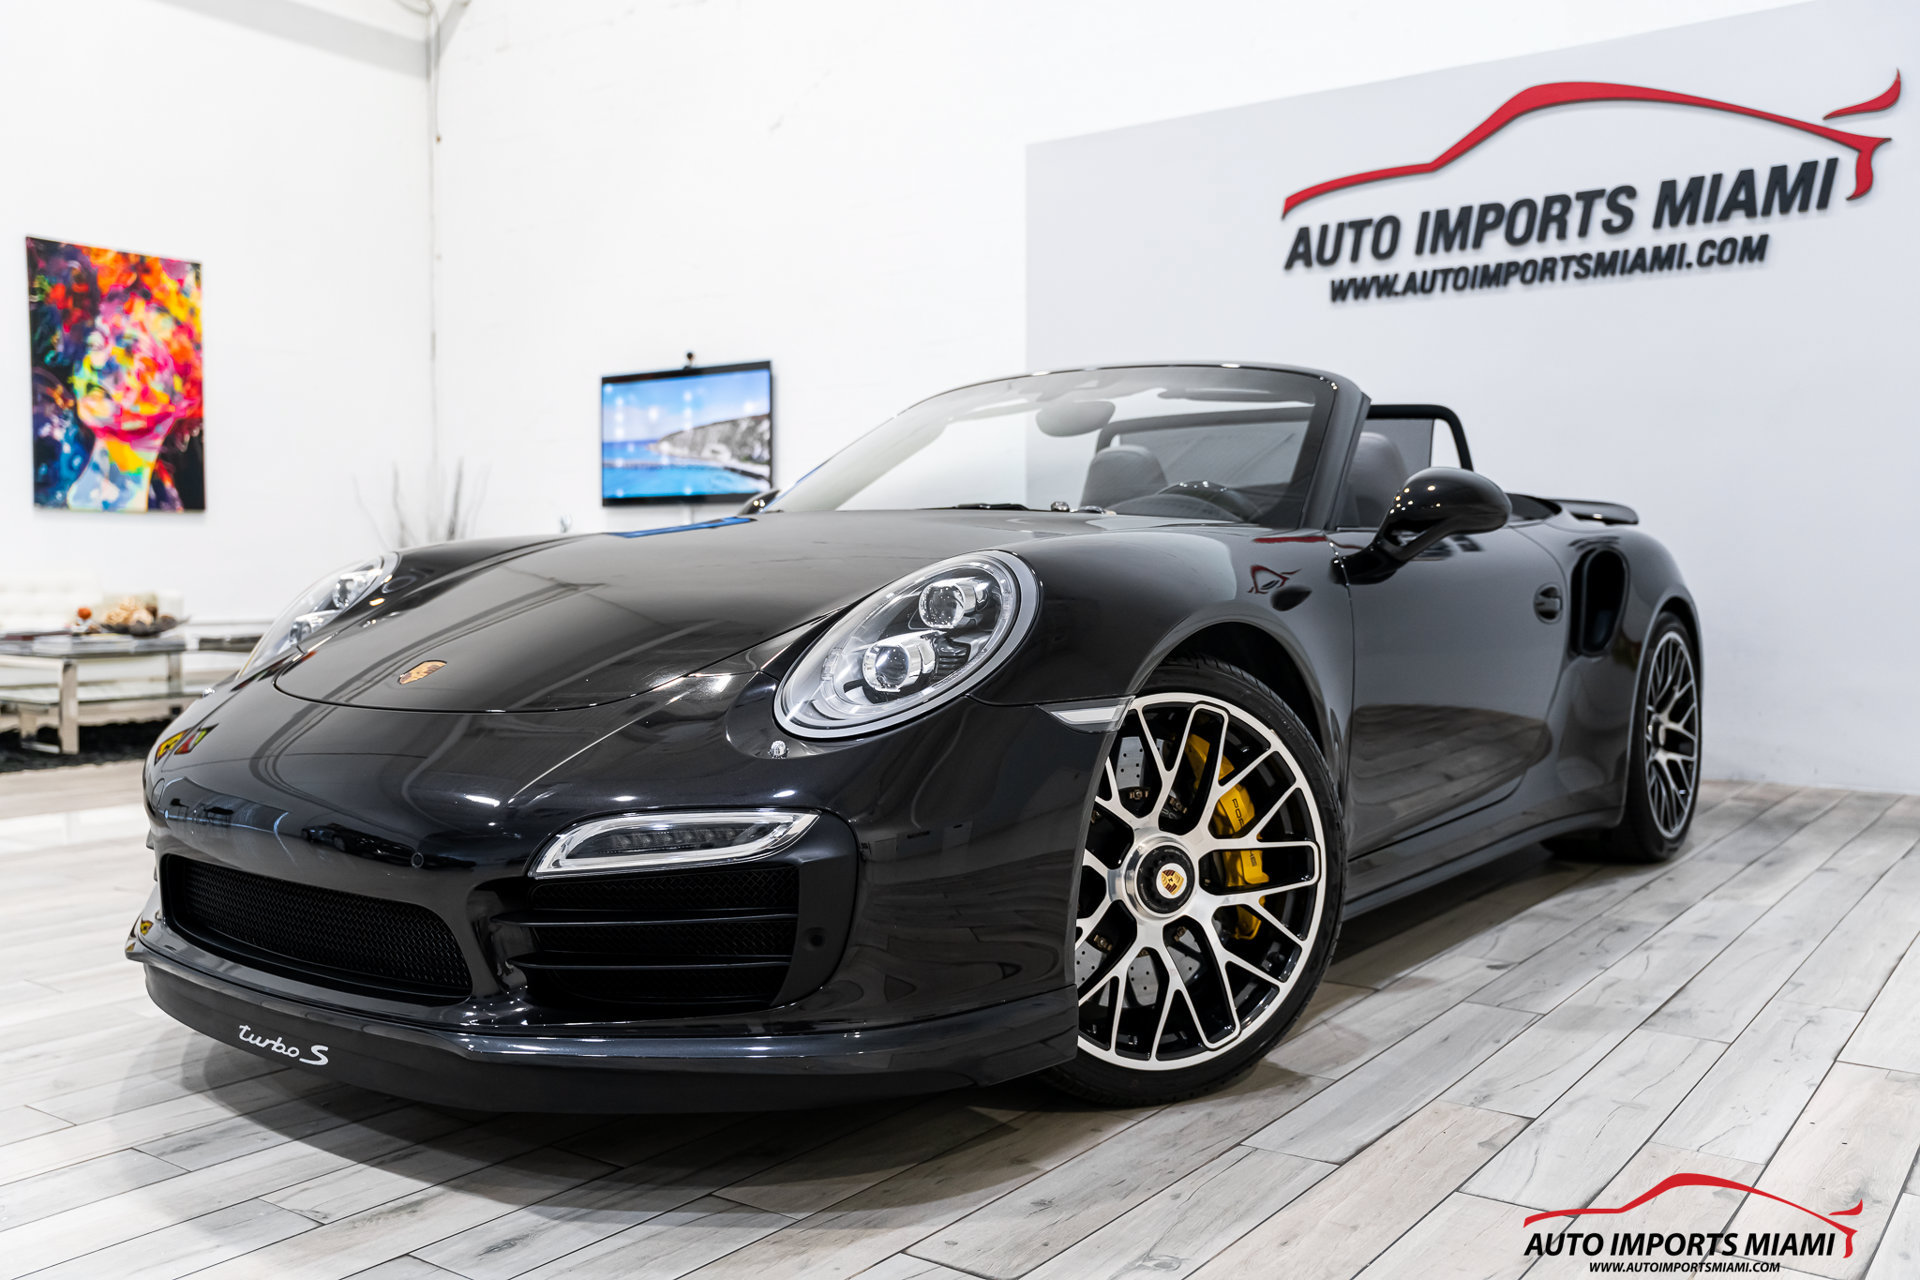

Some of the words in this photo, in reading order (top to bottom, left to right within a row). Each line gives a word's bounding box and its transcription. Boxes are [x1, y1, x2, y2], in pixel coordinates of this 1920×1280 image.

[1284, 215, 1401, 271] AUTO
[1414, 185, 1638, 256] IMPORTS
[1652, 157, 1839, 230] MIAMI
[1330, 233, 1770, 303] WWW.AUTOIMPORTSMIAMI.COM
[238, 1024, 300, 1058] turbo
[299, 1044, 329, 1066] S
